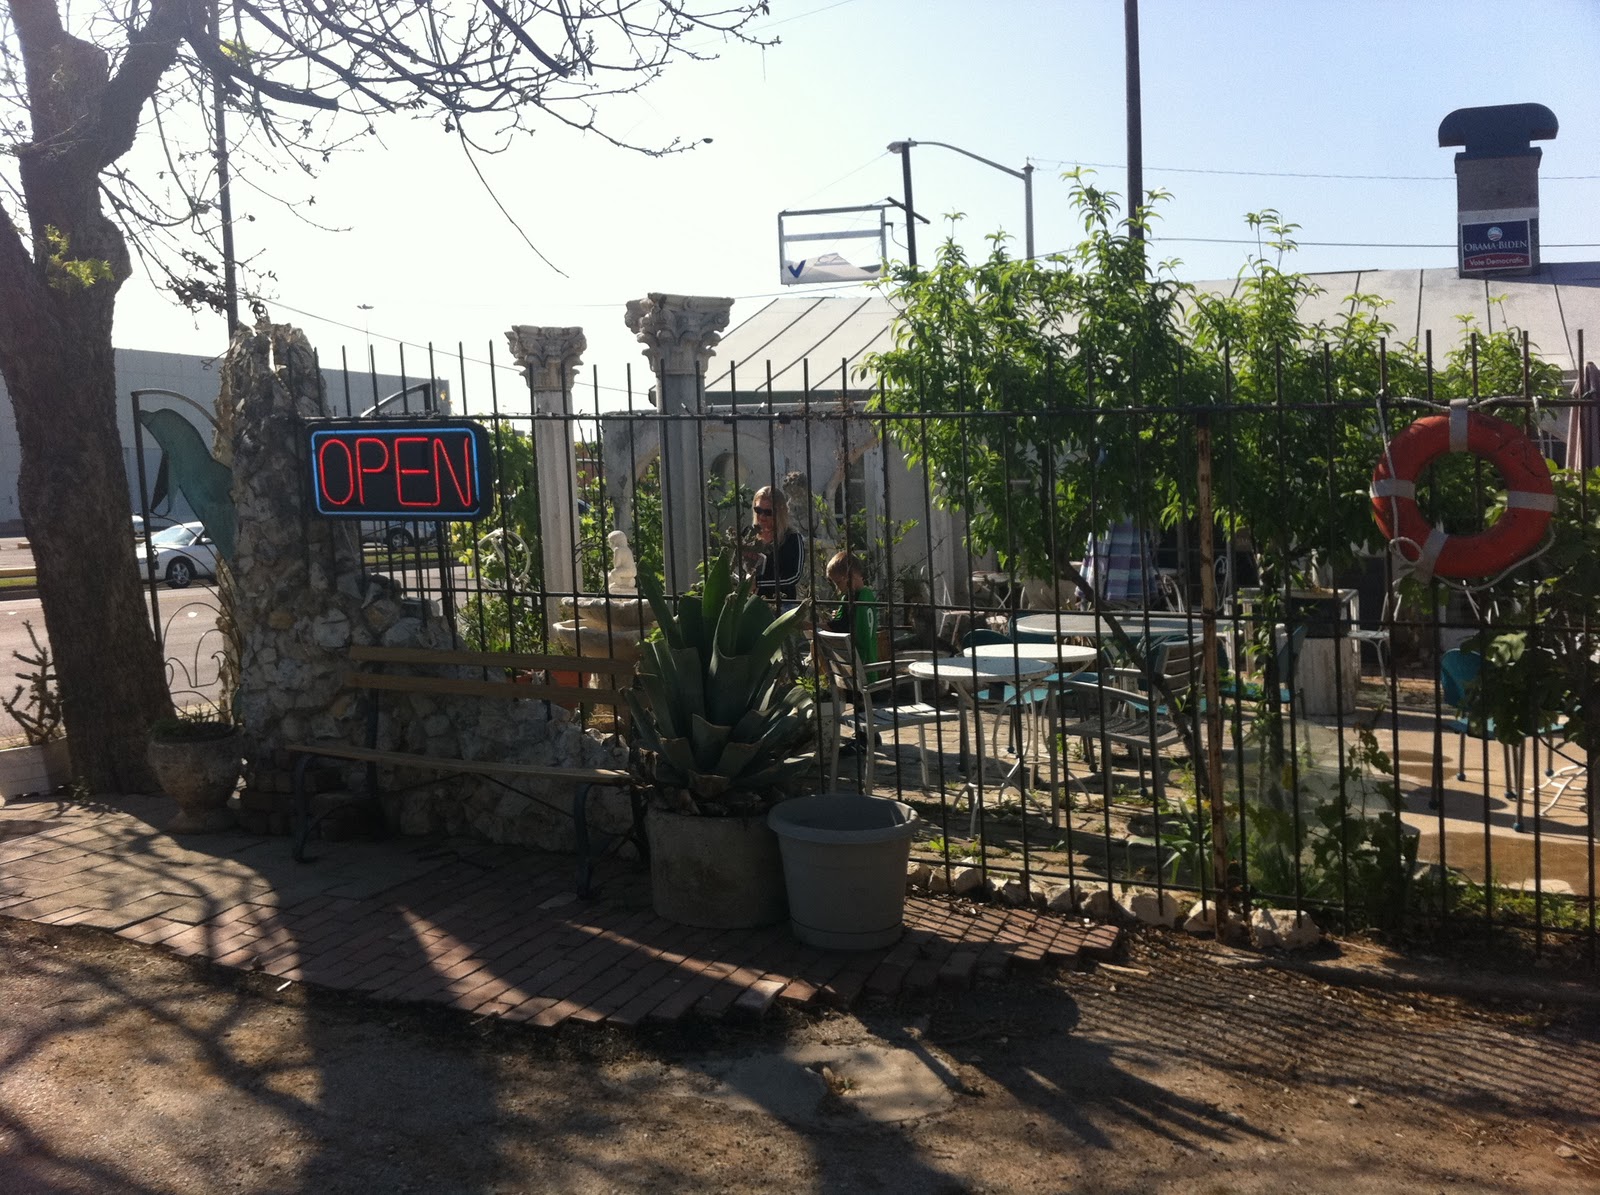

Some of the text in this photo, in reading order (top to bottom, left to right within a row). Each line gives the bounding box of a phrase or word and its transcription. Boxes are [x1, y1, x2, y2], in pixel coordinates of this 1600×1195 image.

[1469, 256, 1525, 266] Vote Democratic
[319, 437, 473, 507] OPEN
